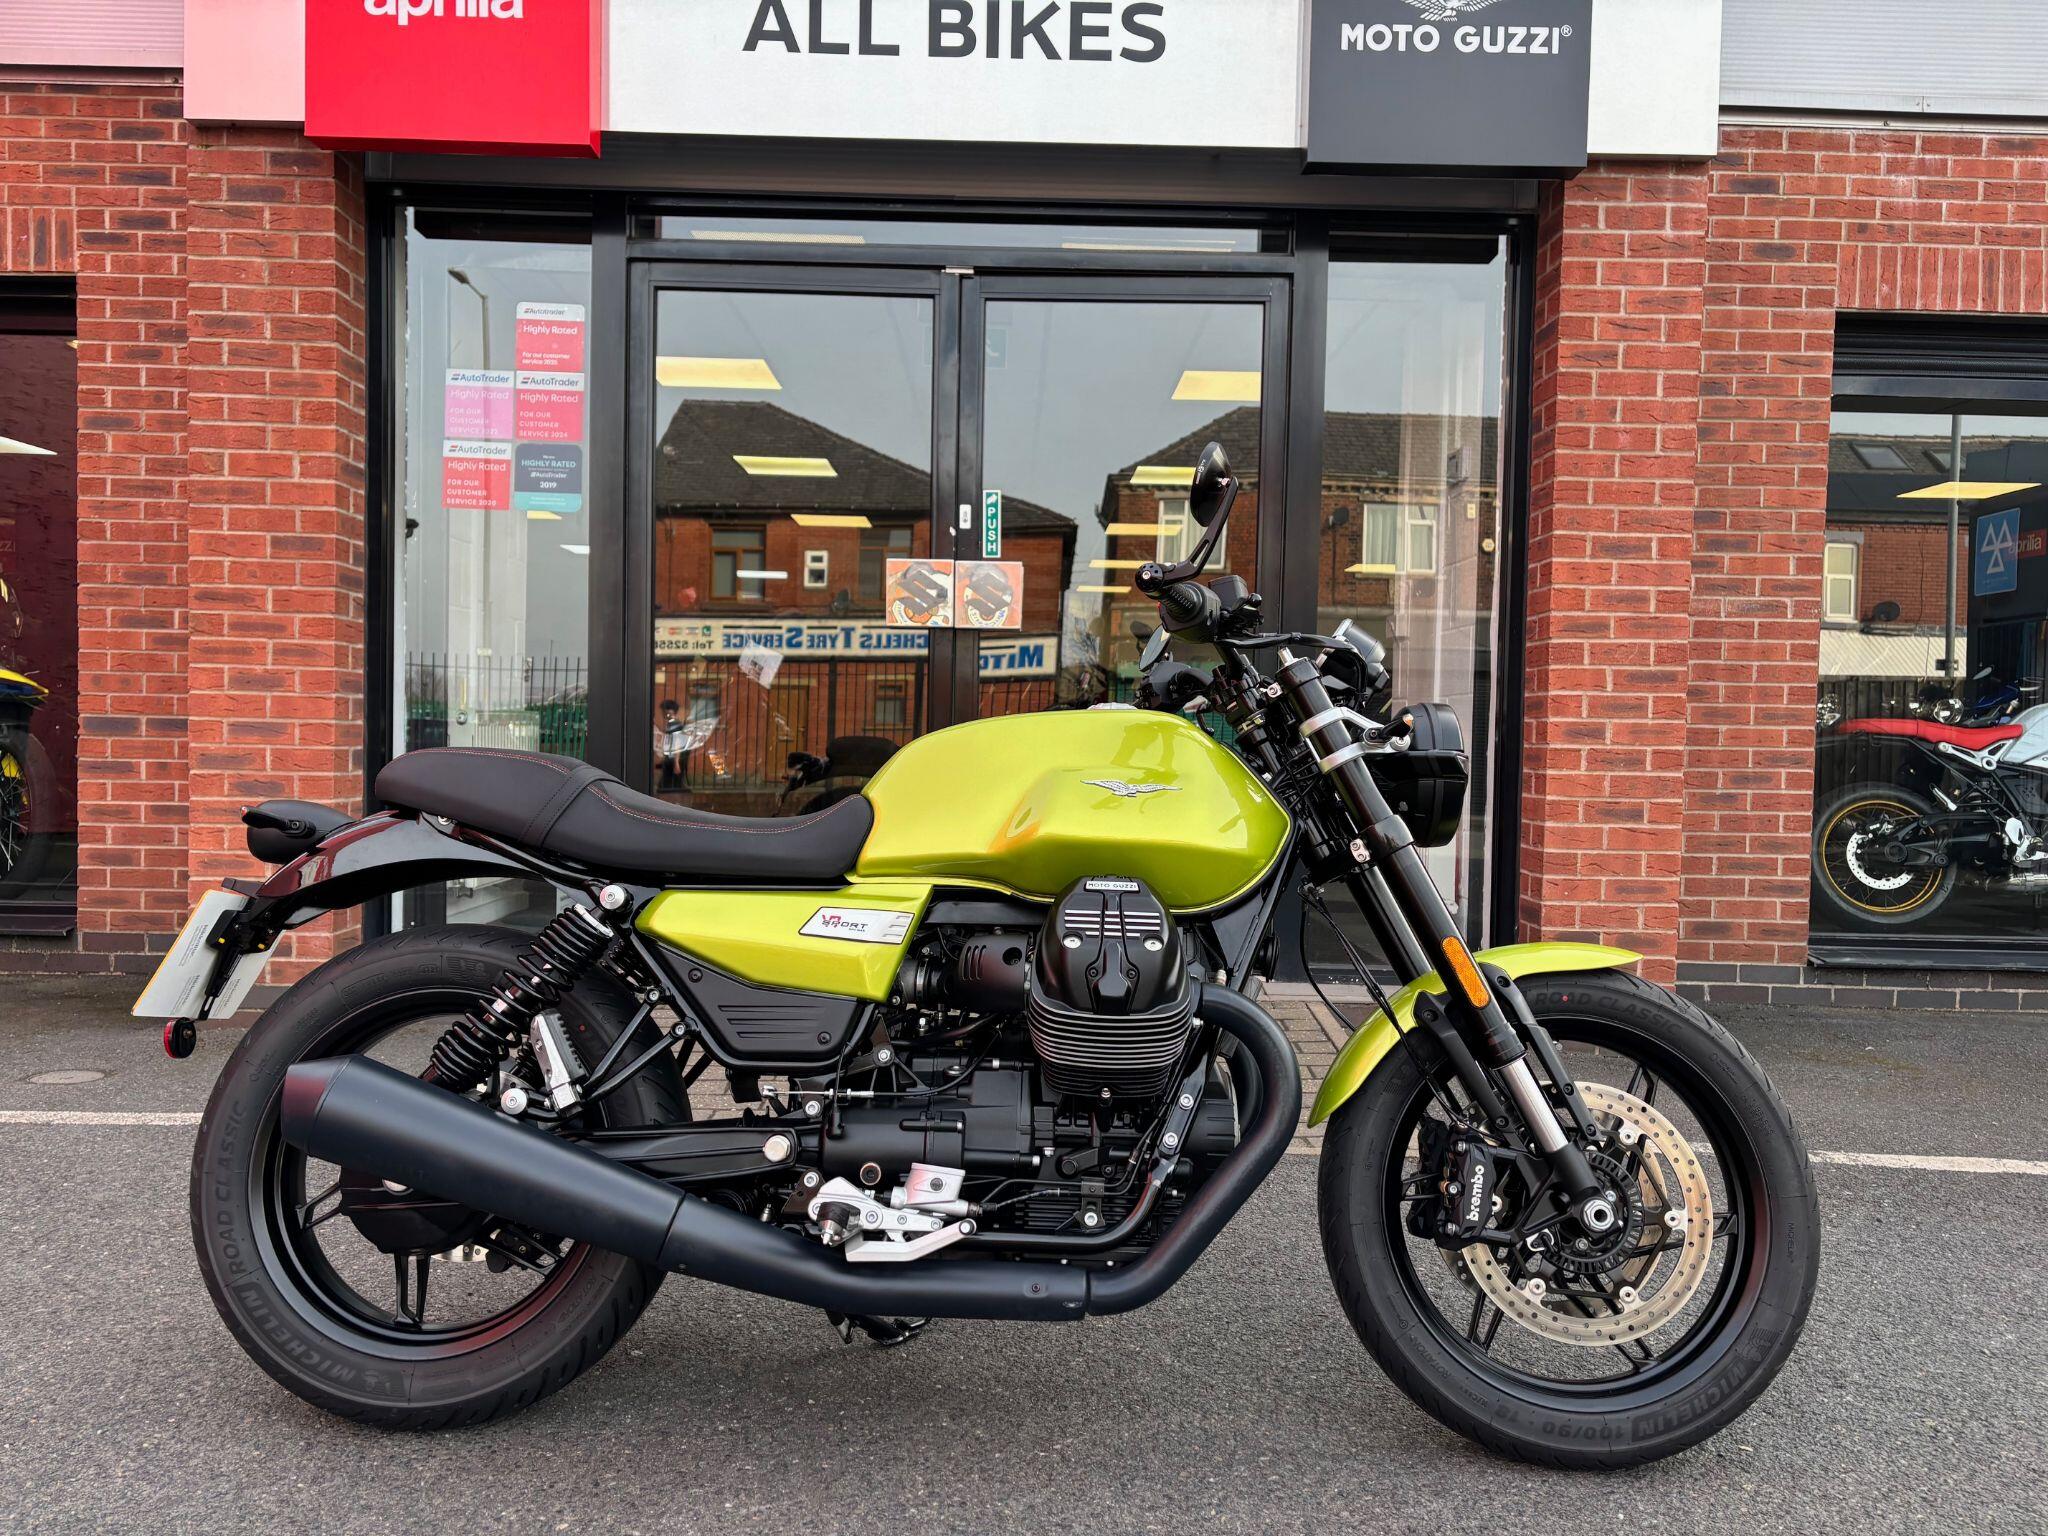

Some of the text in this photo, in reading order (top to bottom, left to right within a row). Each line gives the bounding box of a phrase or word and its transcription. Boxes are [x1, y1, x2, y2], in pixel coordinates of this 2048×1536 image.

[742, 0, 1167, 63] ALL BIKES
[1341, 23, 1440, 52] MOTO
[522, 325, 578, 335] Highly Rated
[460, 374, 510, 383] AutoTrader
[530, 377, 579, 387] AutoTrader
[520, 392, 578, 403] Highly Rated
[457, 446, 507, 455] AutoTrader
[447, 460, 506, 471] Highly Rated
[551, 460, 576, 468] RATED
[539, 481, 557, 489] 2019
[987, 507, 997, 552] PUSH
[2009, 535, 2042, 553] aprilia
[822, 920, 869, 930] SPORT
[1534, 991, 1683, 1036] ROAD CLASSIC
[214, 1101, 247, 1275] ROAD CLASSIC
[1465, 1165, 1485, 1221] brembo
[239, 1288, 358, 1383] MICHELIN
[1636, 1360, 1748, 1436] MICHELIN
